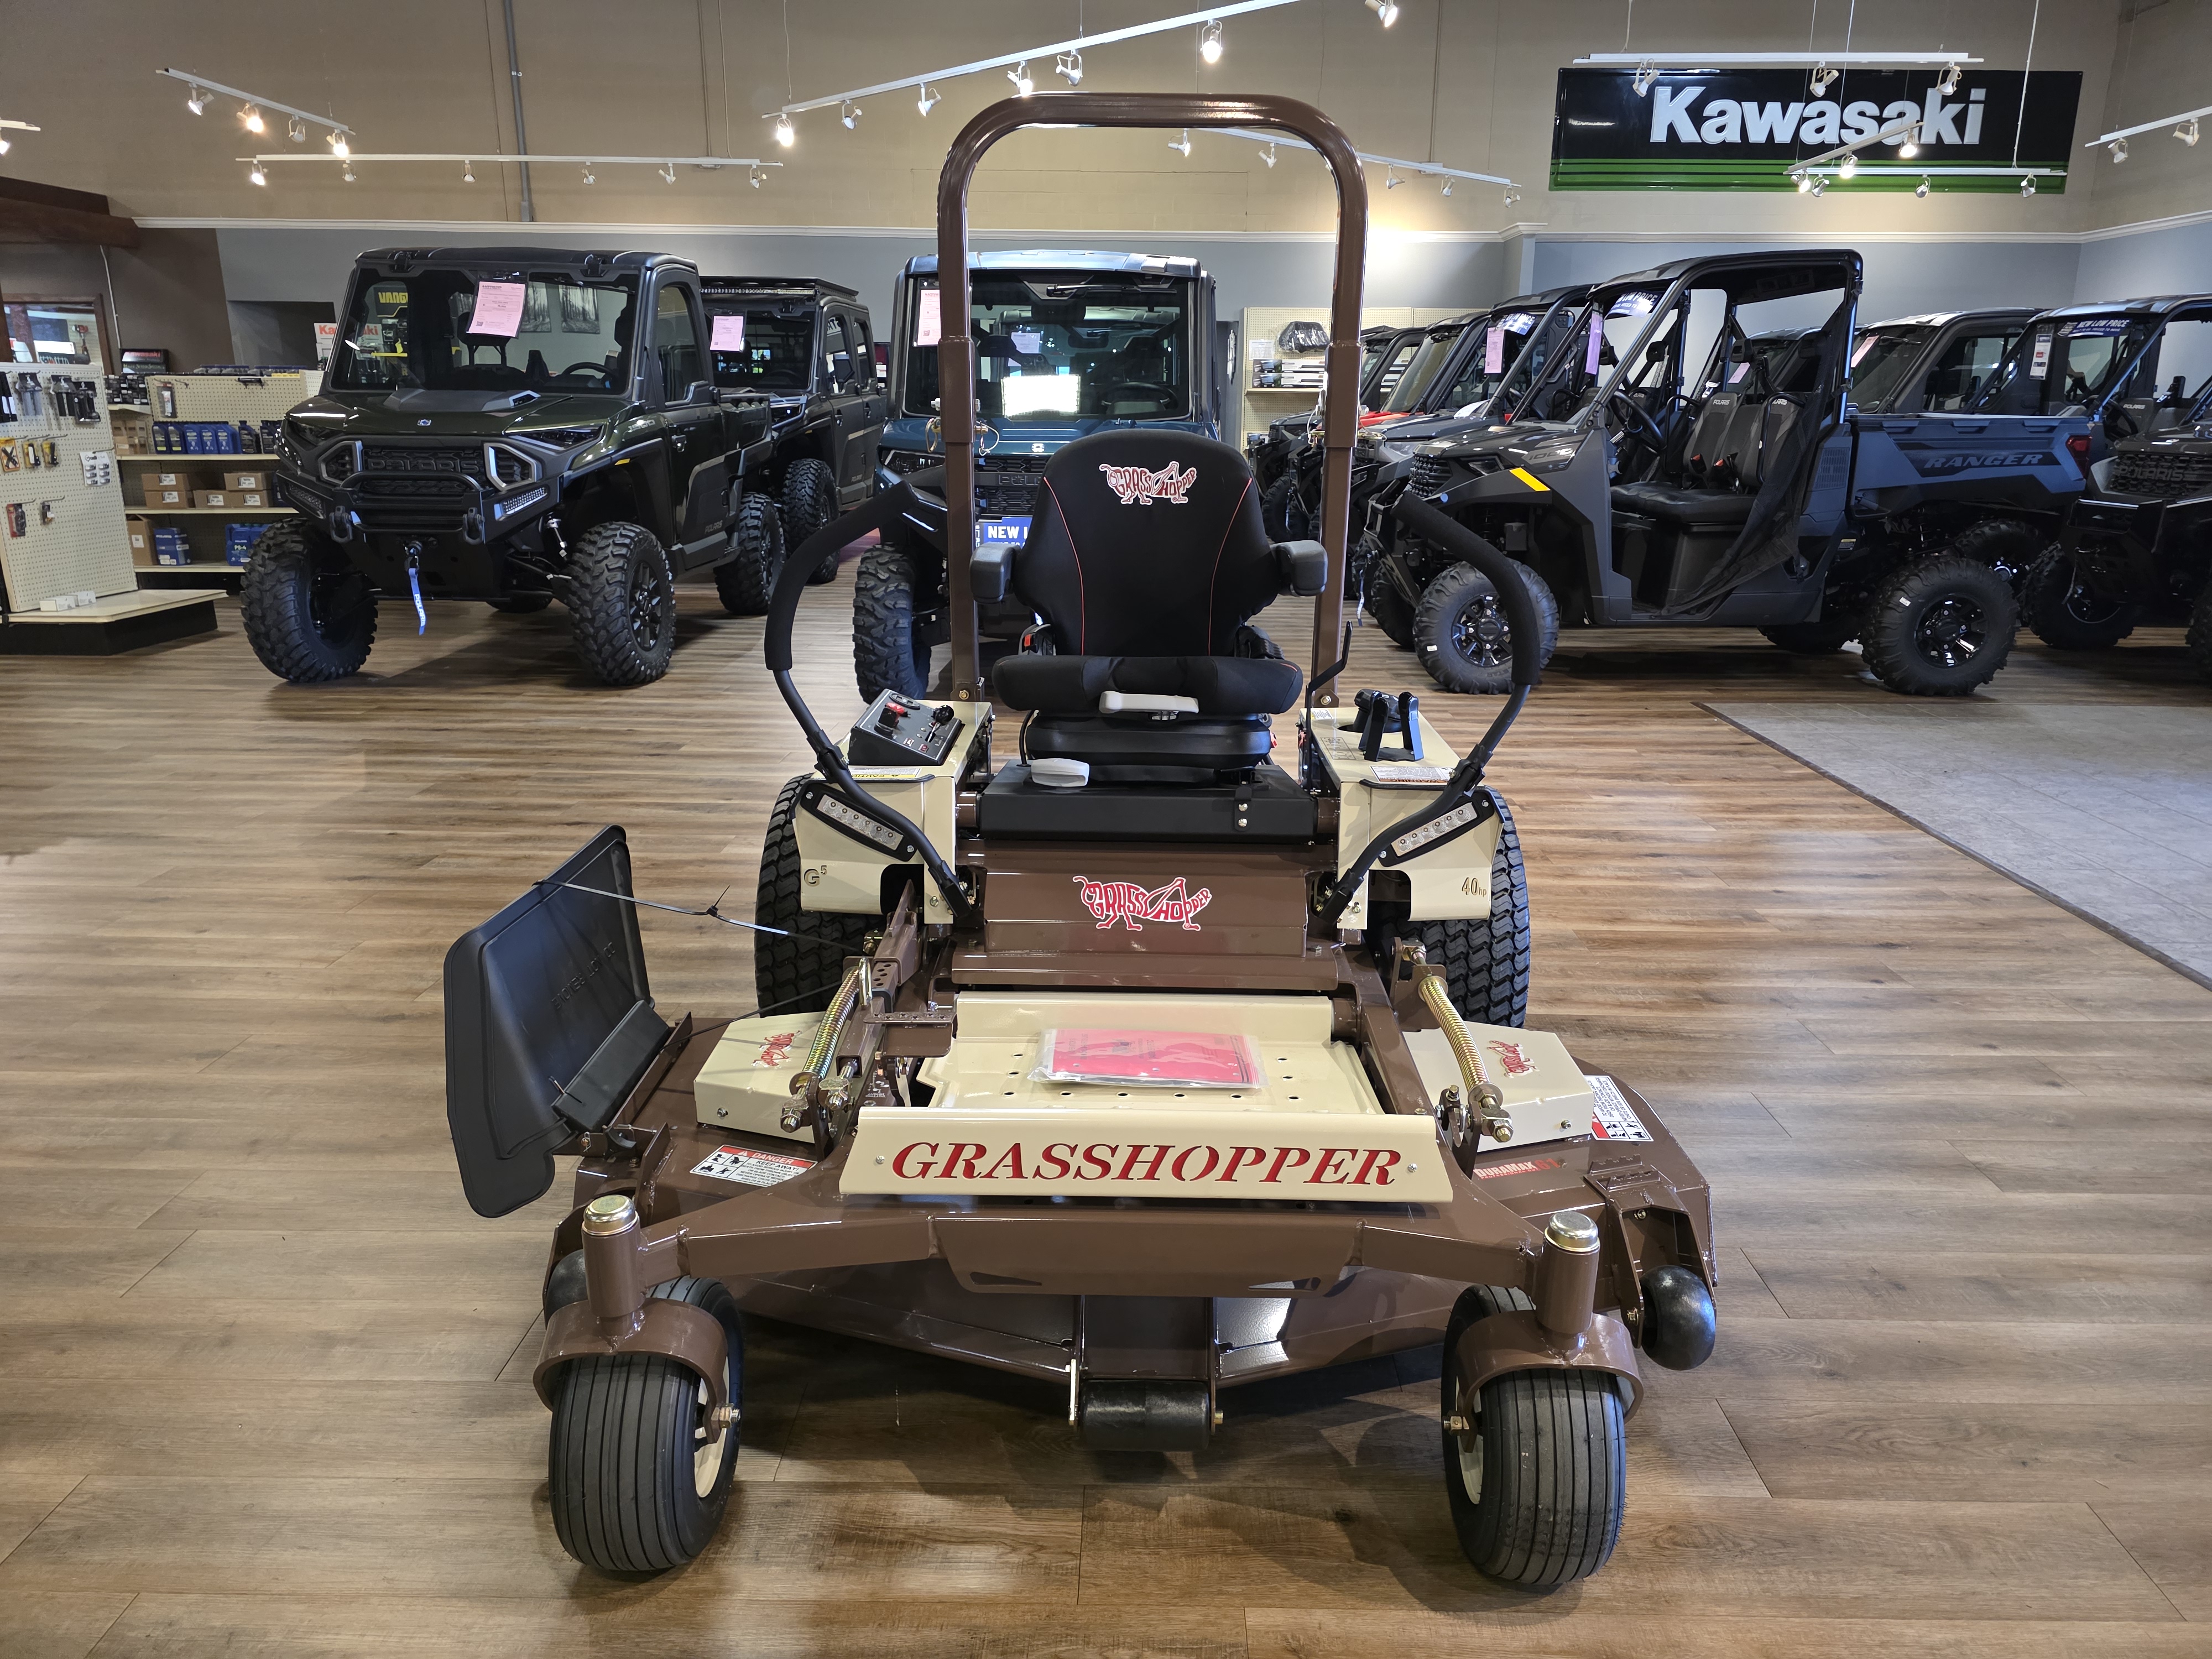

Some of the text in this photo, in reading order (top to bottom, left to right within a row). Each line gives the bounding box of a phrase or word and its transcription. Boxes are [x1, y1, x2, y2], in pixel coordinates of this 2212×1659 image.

[1650, 86, 1986, 145] Kawasaki
[1924, 454, 2043, 469] RANGER
[2117, 465, 2185, 481] POLARIS
[1102, 462, 1197, 503] GRASSHOPPER
[988, 525, 1020, 539] NEW
[1075, 877, 1212, 929] GRASSHOPPER
[752, 1152, 794, 1165] DANGER
[891, 1142, 1401, 1187] GRASSHOPPER
[1535, 1158, 1560, 1170] 61
[1481, 1170, 1526, 1180] PROFESSIONAL
